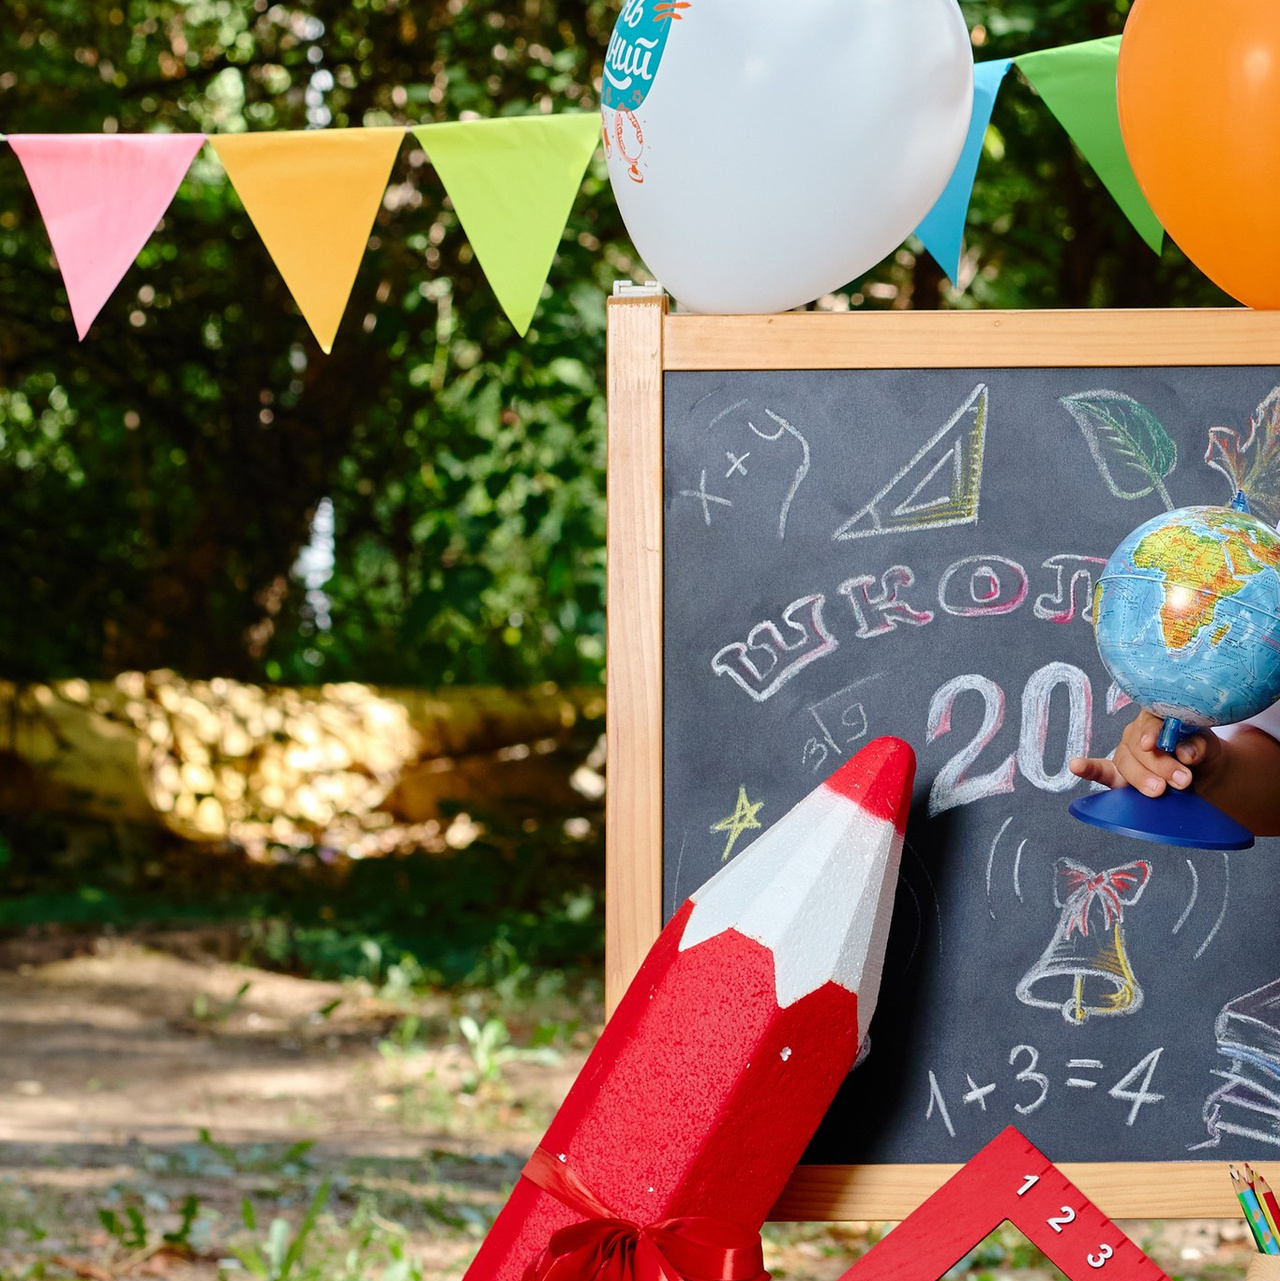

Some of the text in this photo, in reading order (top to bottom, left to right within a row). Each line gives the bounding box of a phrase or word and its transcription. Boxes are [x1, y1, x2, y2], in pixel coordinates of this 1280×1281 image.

[605, 29, 659, 80] ний
[711, 554, 1108, 703] ШКОЛ
[925, 660, 1133, 818] 20
[1016, 1174, 1040, 1197] 1
[1046, 1205, 1077, 1234] 2
[1086, 1243, 1114, 1269] 3
